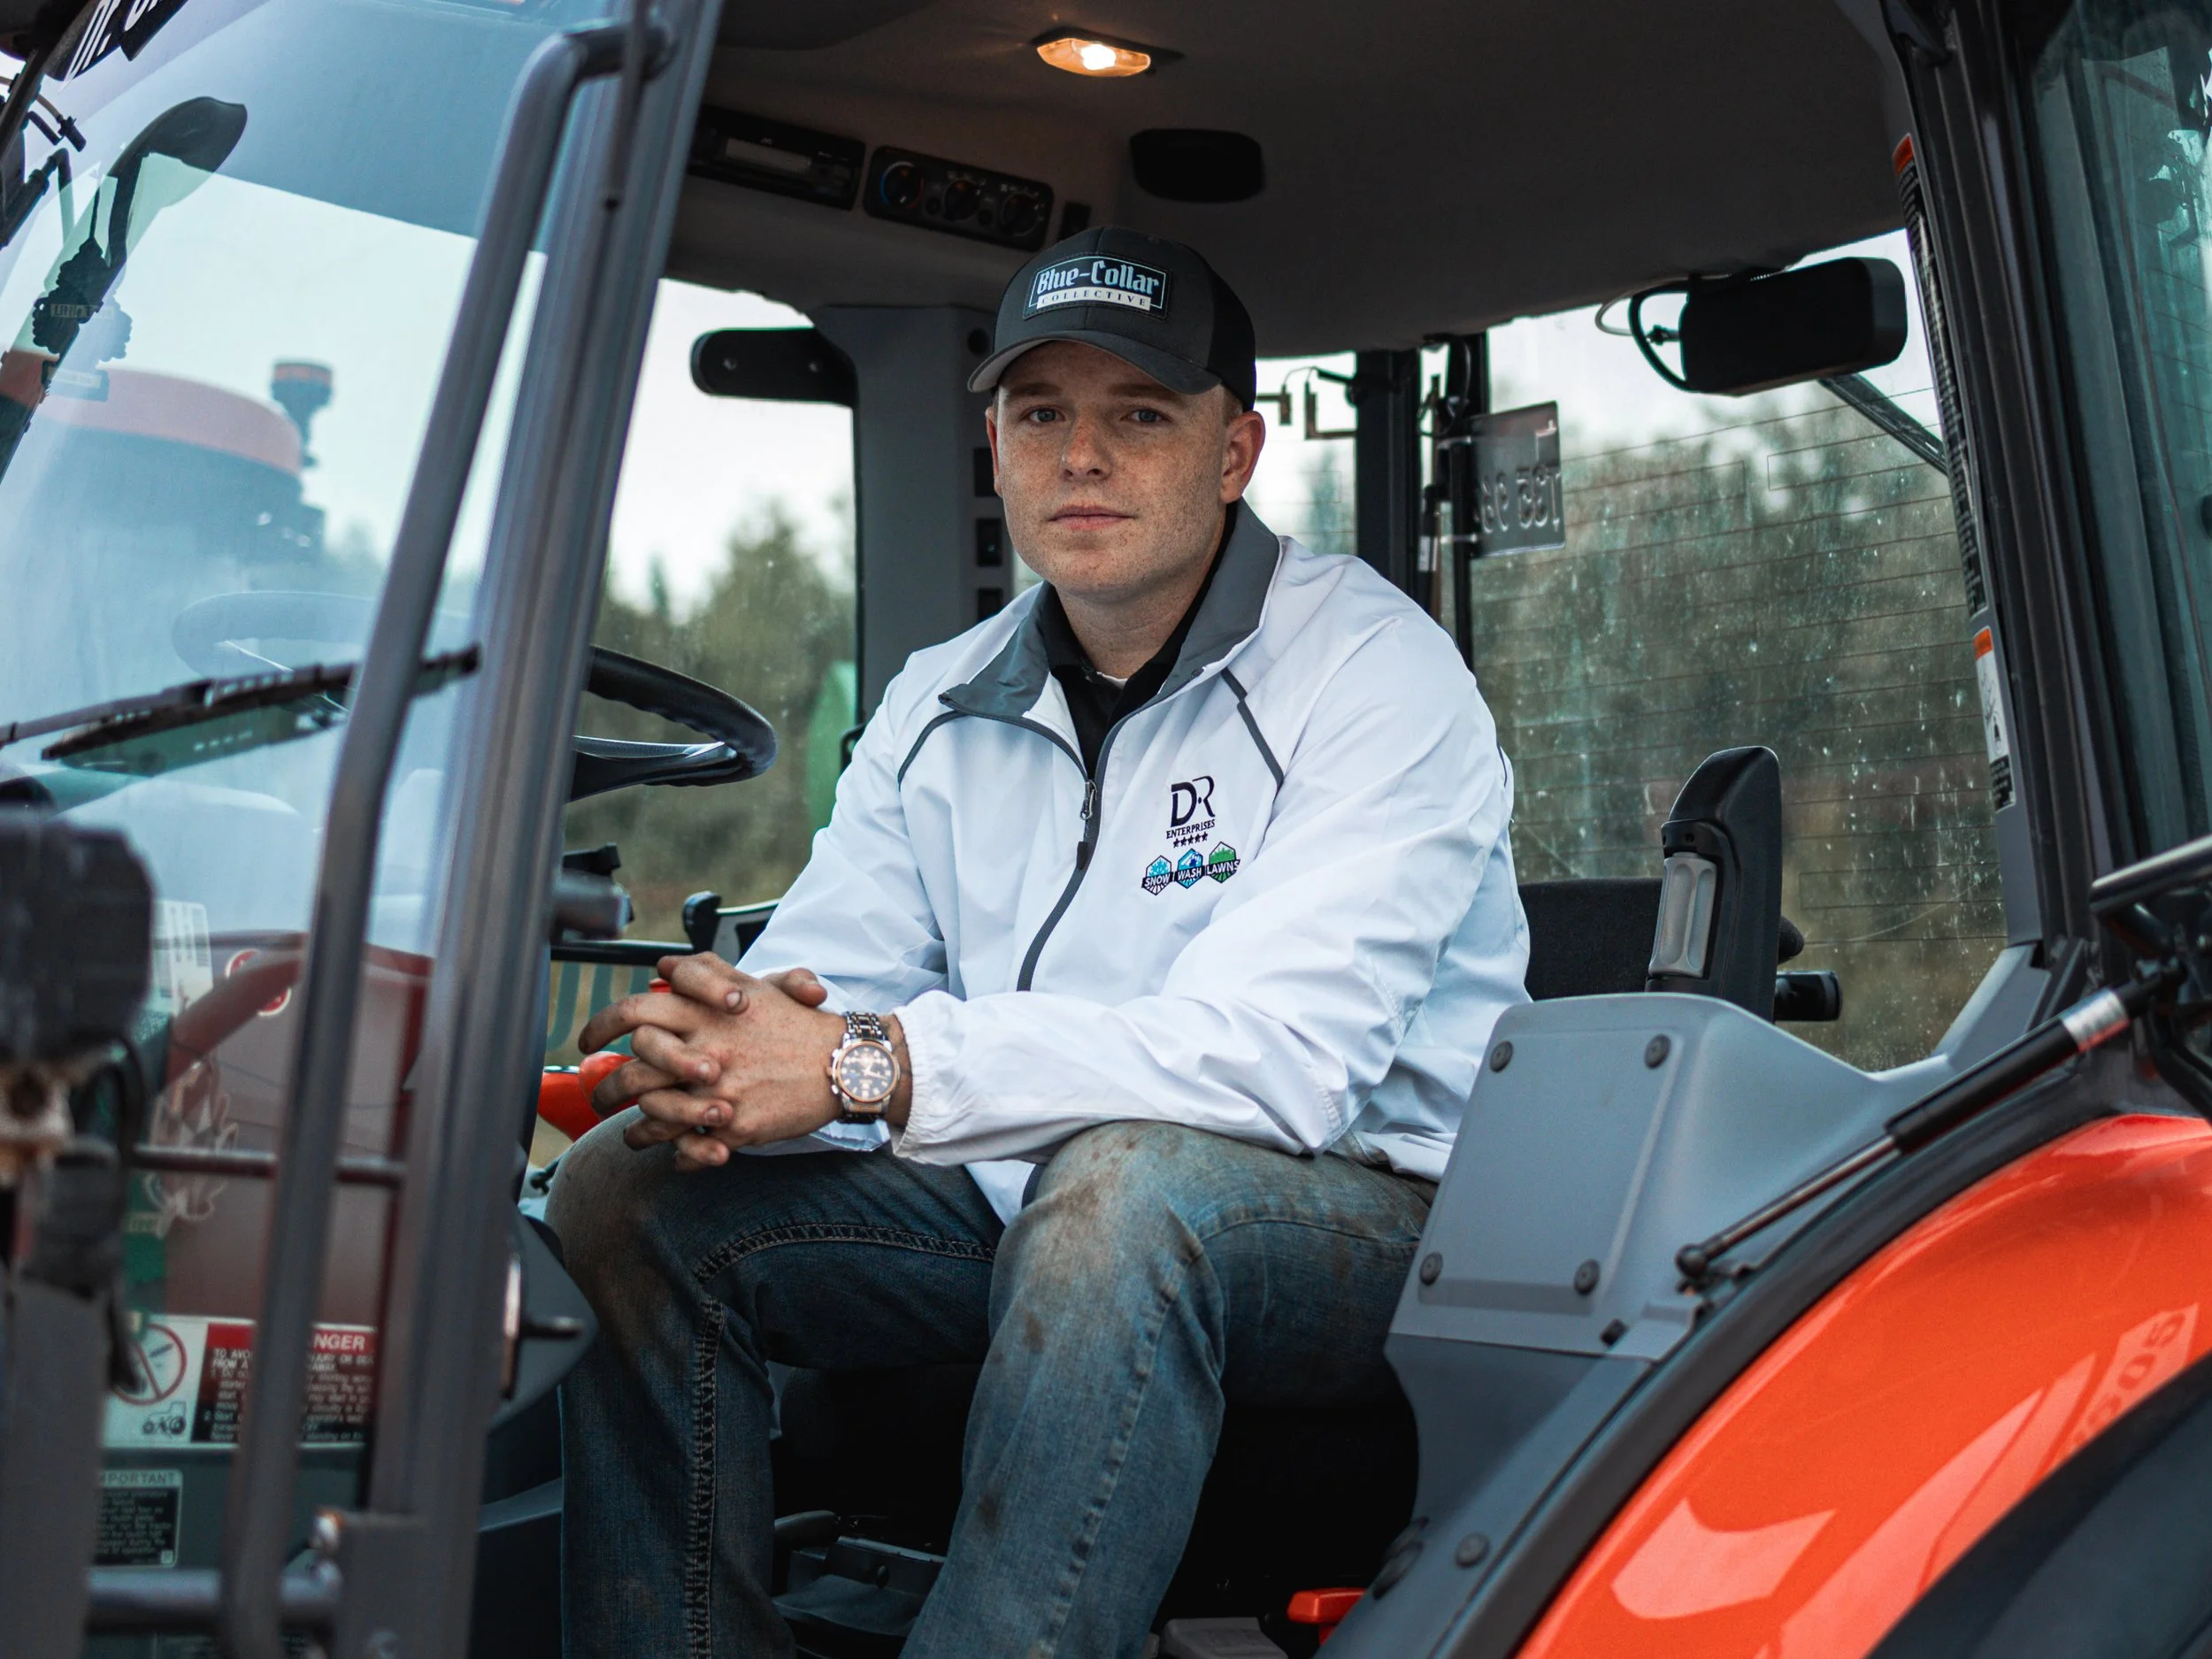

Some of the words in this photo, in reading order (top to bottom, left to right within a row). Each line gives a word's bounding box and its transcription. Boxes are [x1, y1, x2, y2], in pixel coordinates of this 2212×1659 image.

[1037, 260, 1159, 295] Blue-Collar
[1041, 289, 1146, 306] COLLECTIVE
[1166, 818, 1216, 839] ENTERPRISES
[1144, 872, 1171, 886] SNOW
[1178, 867, 1202, 880] WASH
[1206, 859, 1240, 875] LAWNS
[314, 1333, 366, 1351] NGER
[99, 1471, 174, 1485] PORTANT
